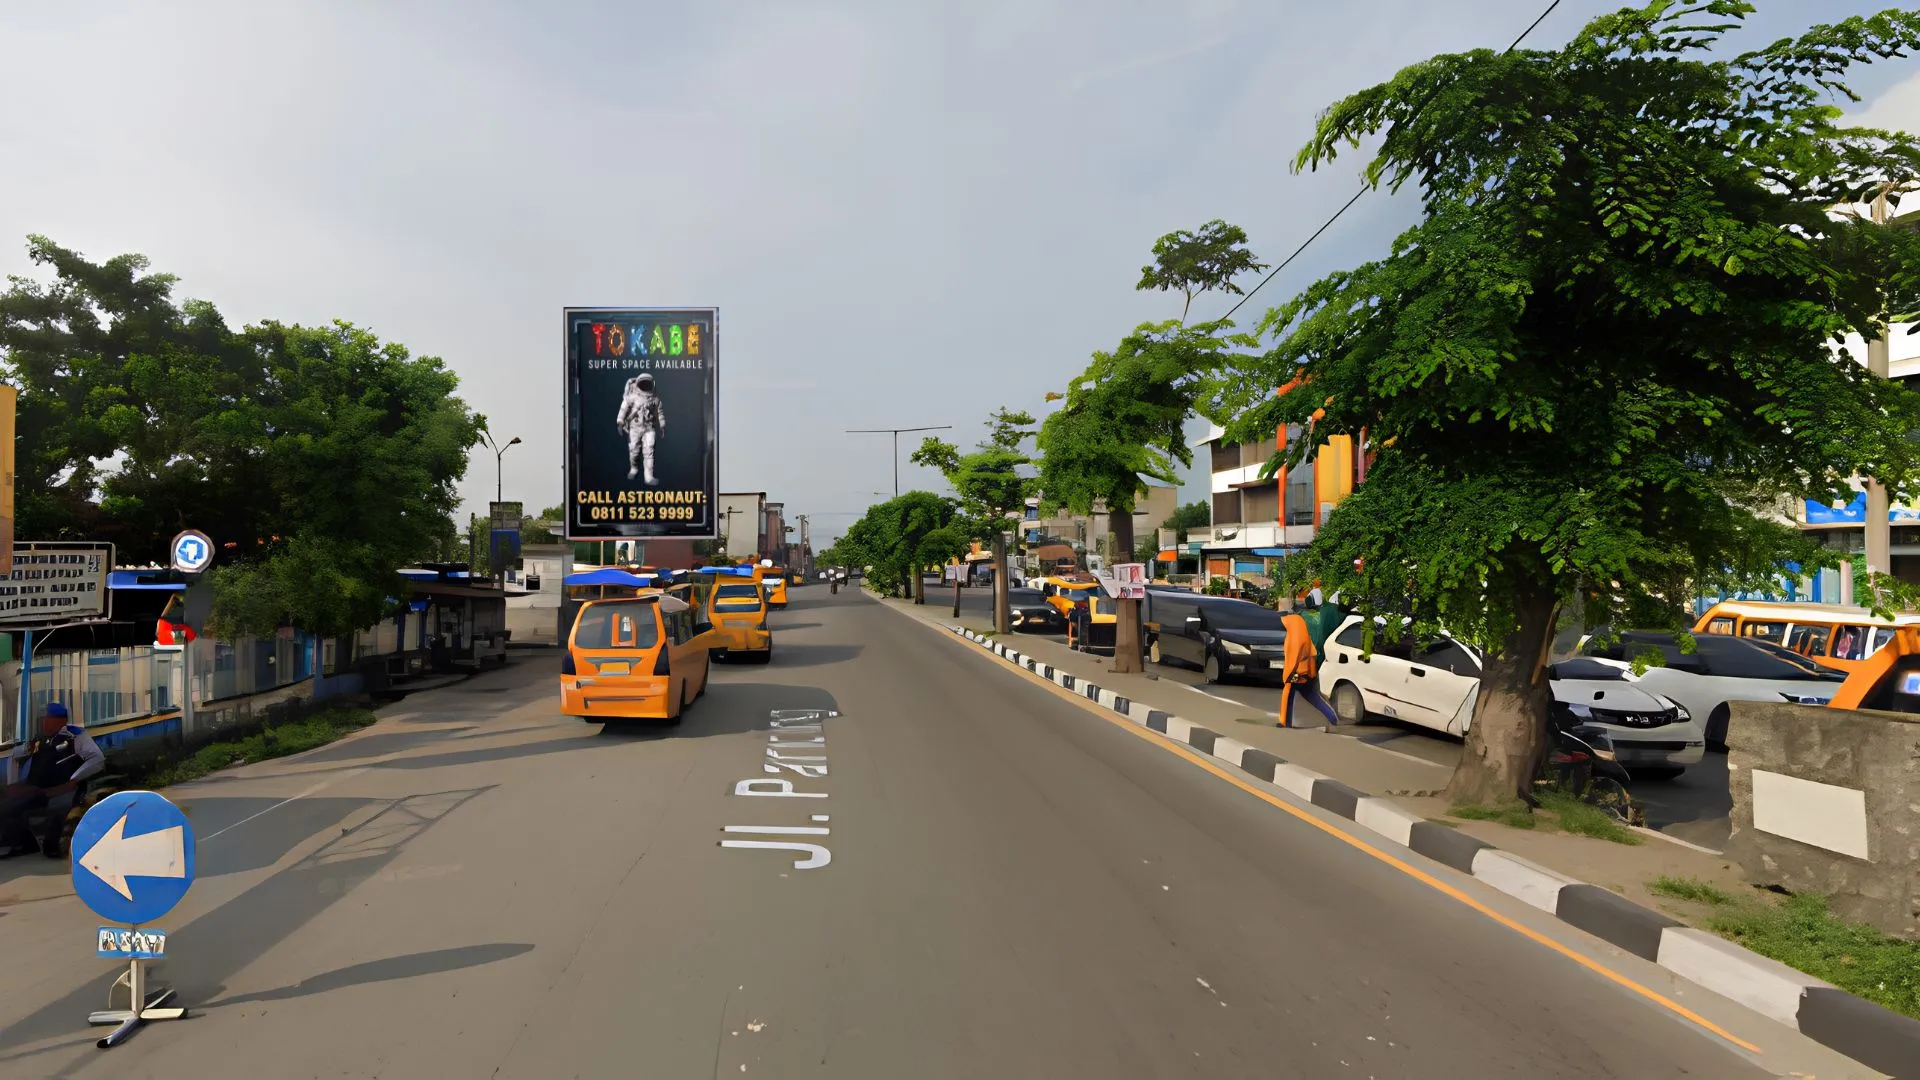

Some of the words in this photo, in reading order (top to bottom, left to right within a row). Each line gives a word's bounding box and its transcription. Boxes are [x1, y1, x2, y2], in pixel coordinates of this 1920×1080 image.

[591, 323, 700, 357] TOKABE
[588, 359, 618, 369] SUPER
[622, 359, 651, 369] SPACE
[655, 359, 703, 369] AVAILABLE
[578, 490, 613, 504] CALL
[617, 490, 707, 504] ASTRONAUT:
[591, 507, 624, 520] 0811
[629, 507, 655, 520] 523
[659, 507, 694, 520] 9999
